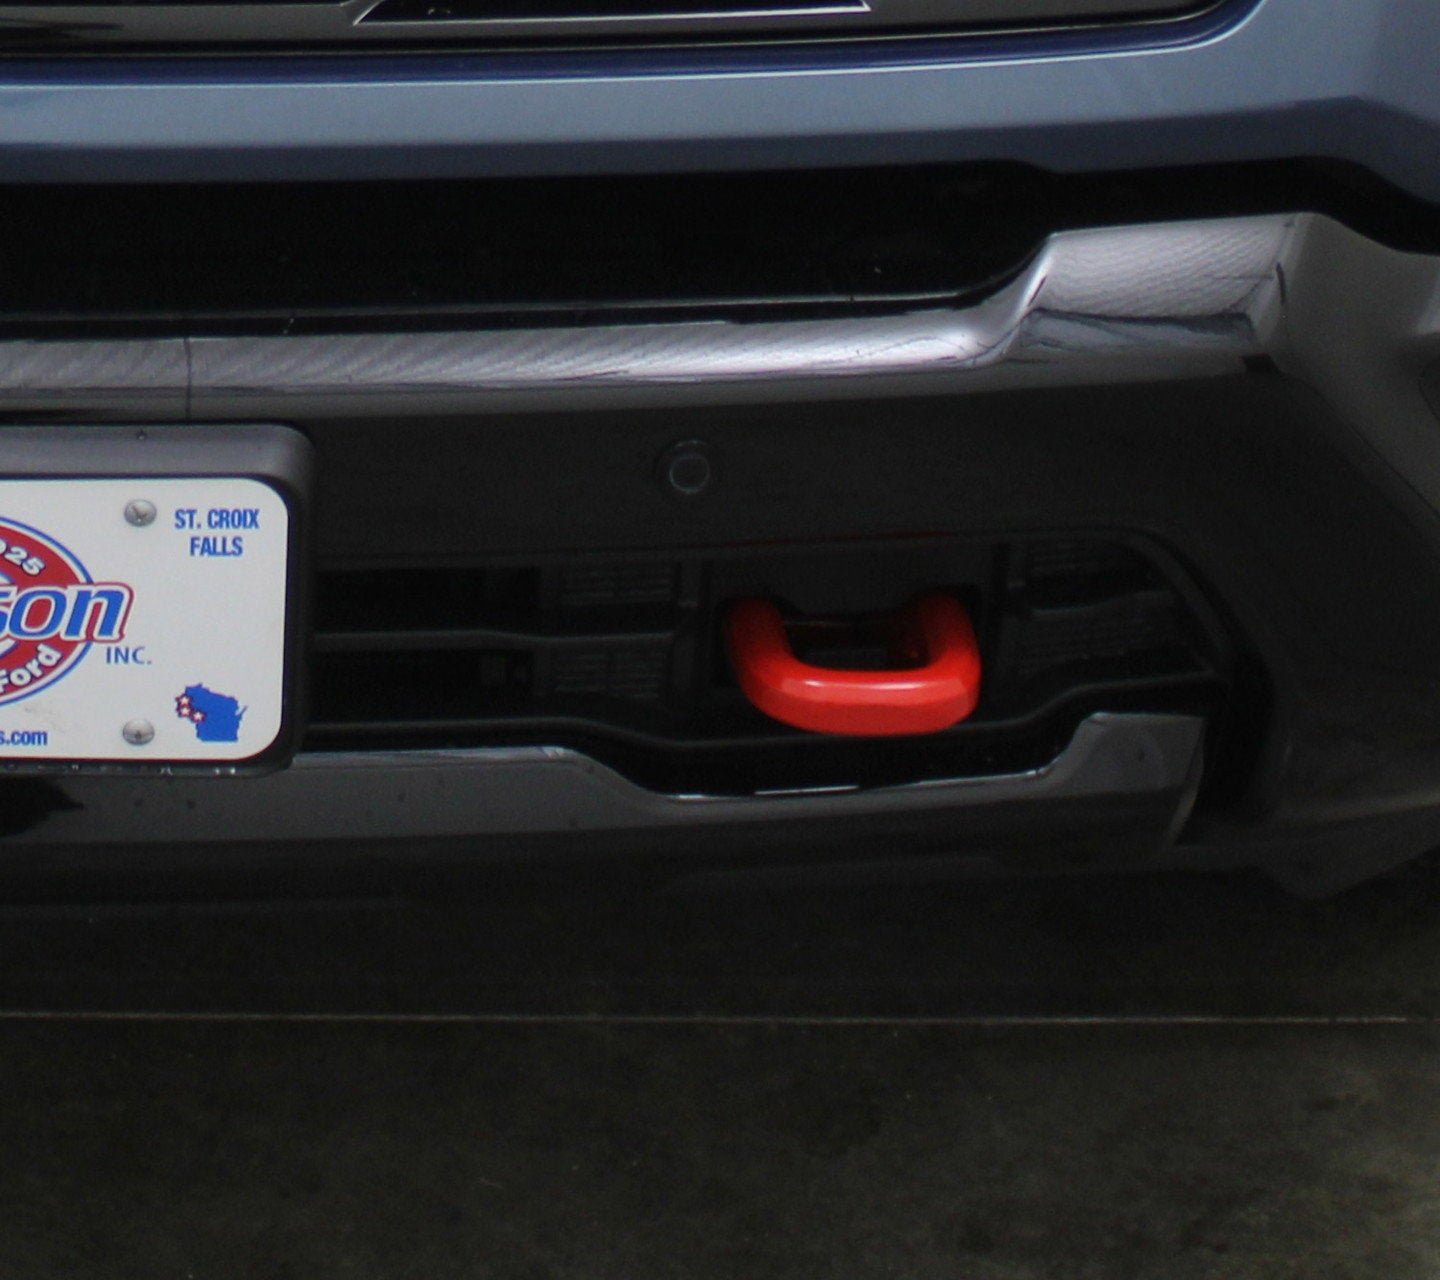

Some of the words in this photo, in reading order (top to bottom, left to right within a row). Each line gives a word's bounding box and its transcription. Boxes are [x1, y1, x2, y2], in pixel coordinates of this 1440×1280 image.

[174, 508, 202, 529] ST.
[207, 508, 260, 530] CROIX
[189, 535, 244, 557] FALLS
[105, 645, 152, 666] INC.
